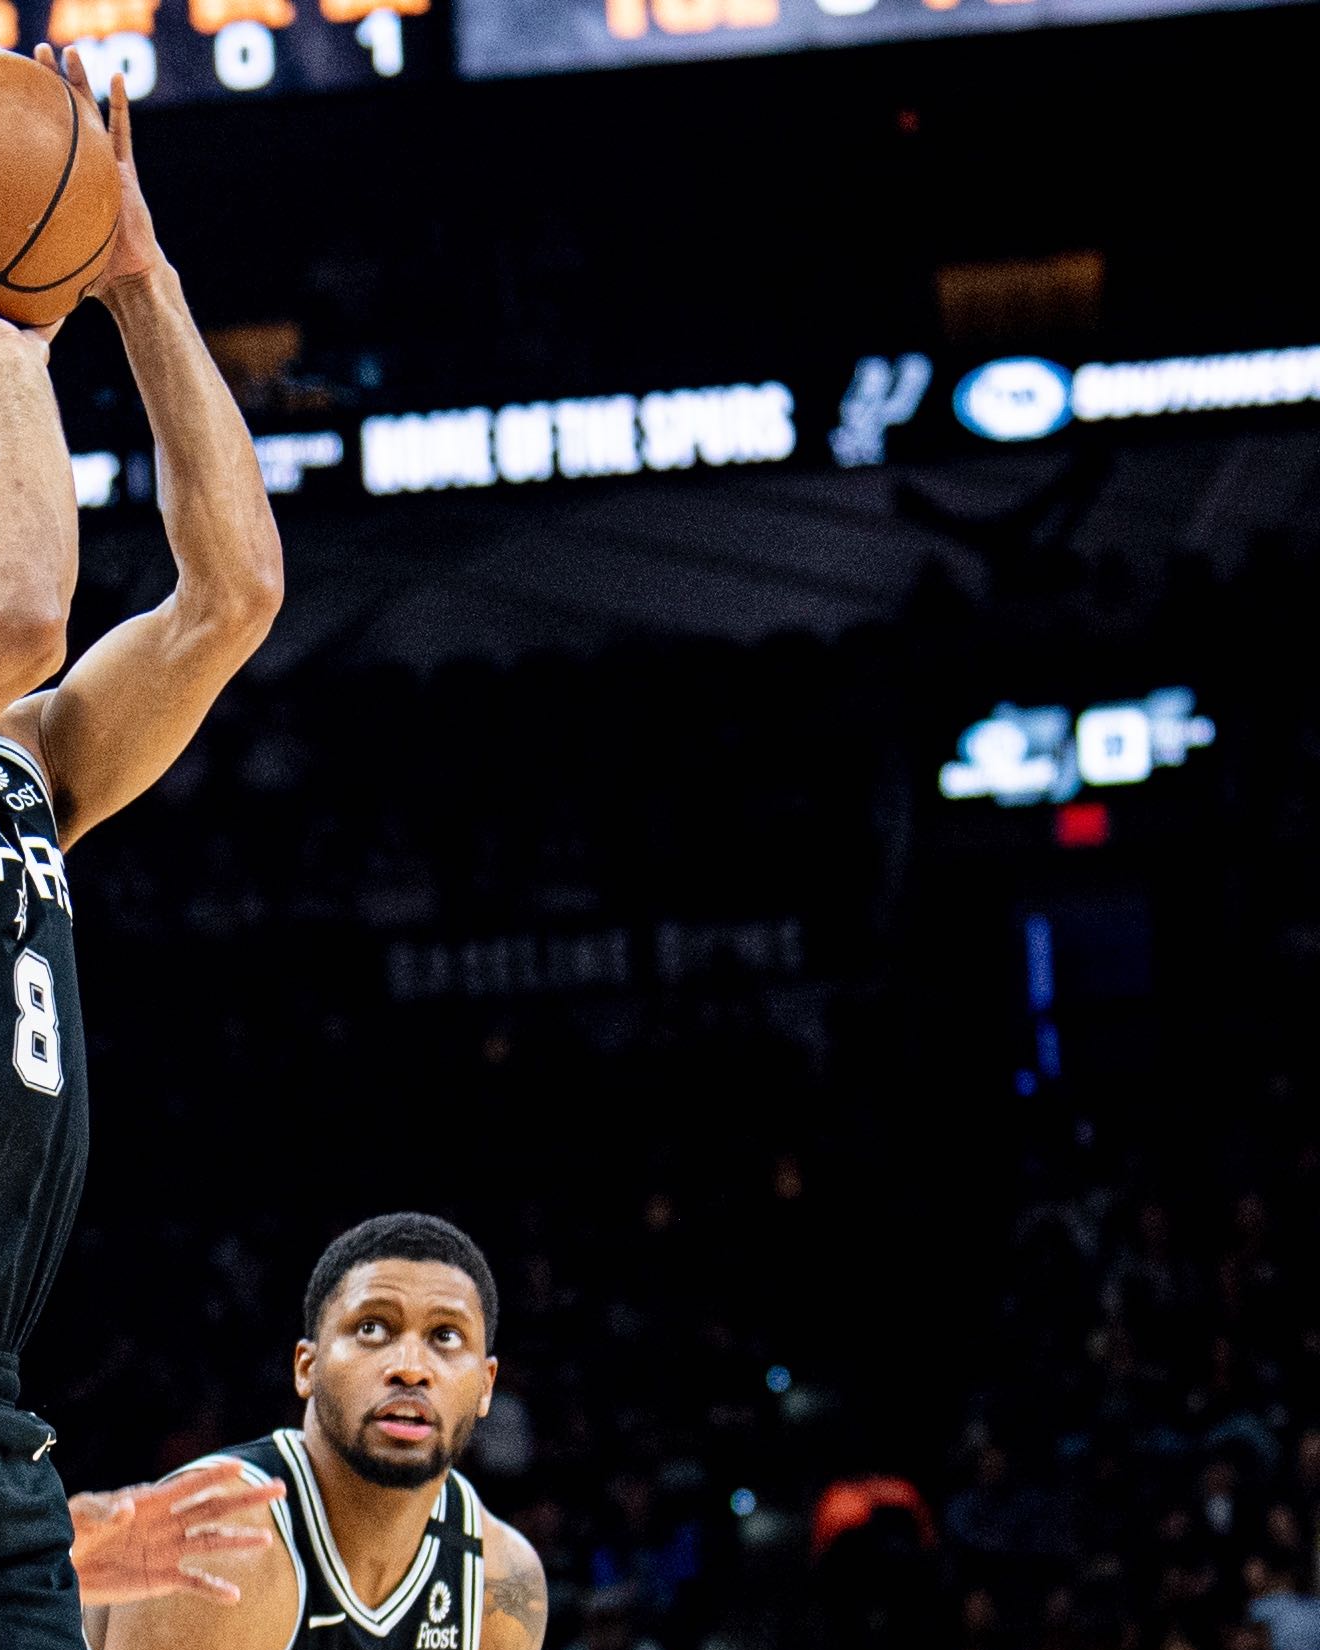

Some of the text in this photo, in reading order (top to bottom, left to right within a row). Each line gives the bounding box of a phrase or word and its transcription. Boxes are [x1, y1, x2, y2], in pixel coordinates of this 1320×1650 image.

[6, 782, 44, 811] ost
[12, 947, 65, 1097] 8
[416, 1623, 458, 1650] Frost
